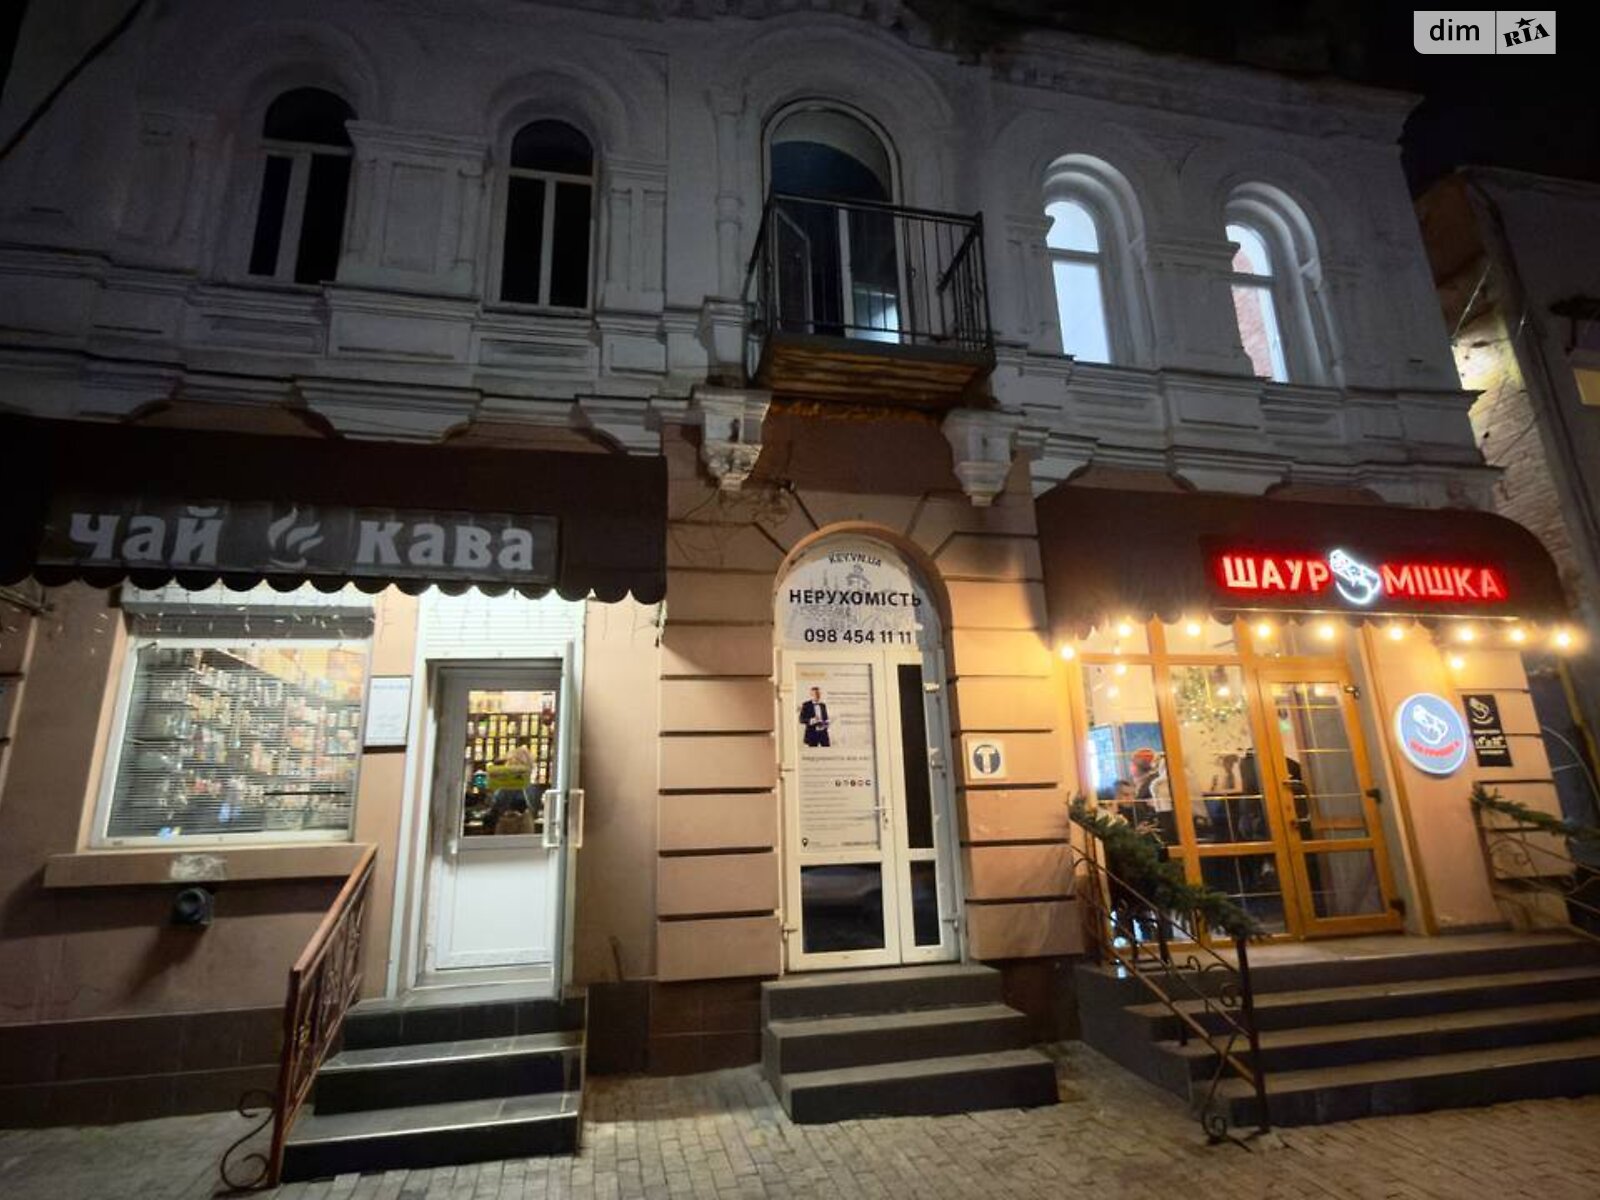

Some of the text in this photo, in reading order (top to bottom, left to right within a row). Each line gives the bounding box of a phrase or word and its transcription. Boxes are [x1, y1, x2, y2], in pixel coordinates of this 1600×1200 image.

[1221, 555, 1507, 599] ШАУР МІШКА
[788, 588, 923, 608] НЕРУХОМІСТЬ
[804, 628, 912, 645] 098 454 11 11
